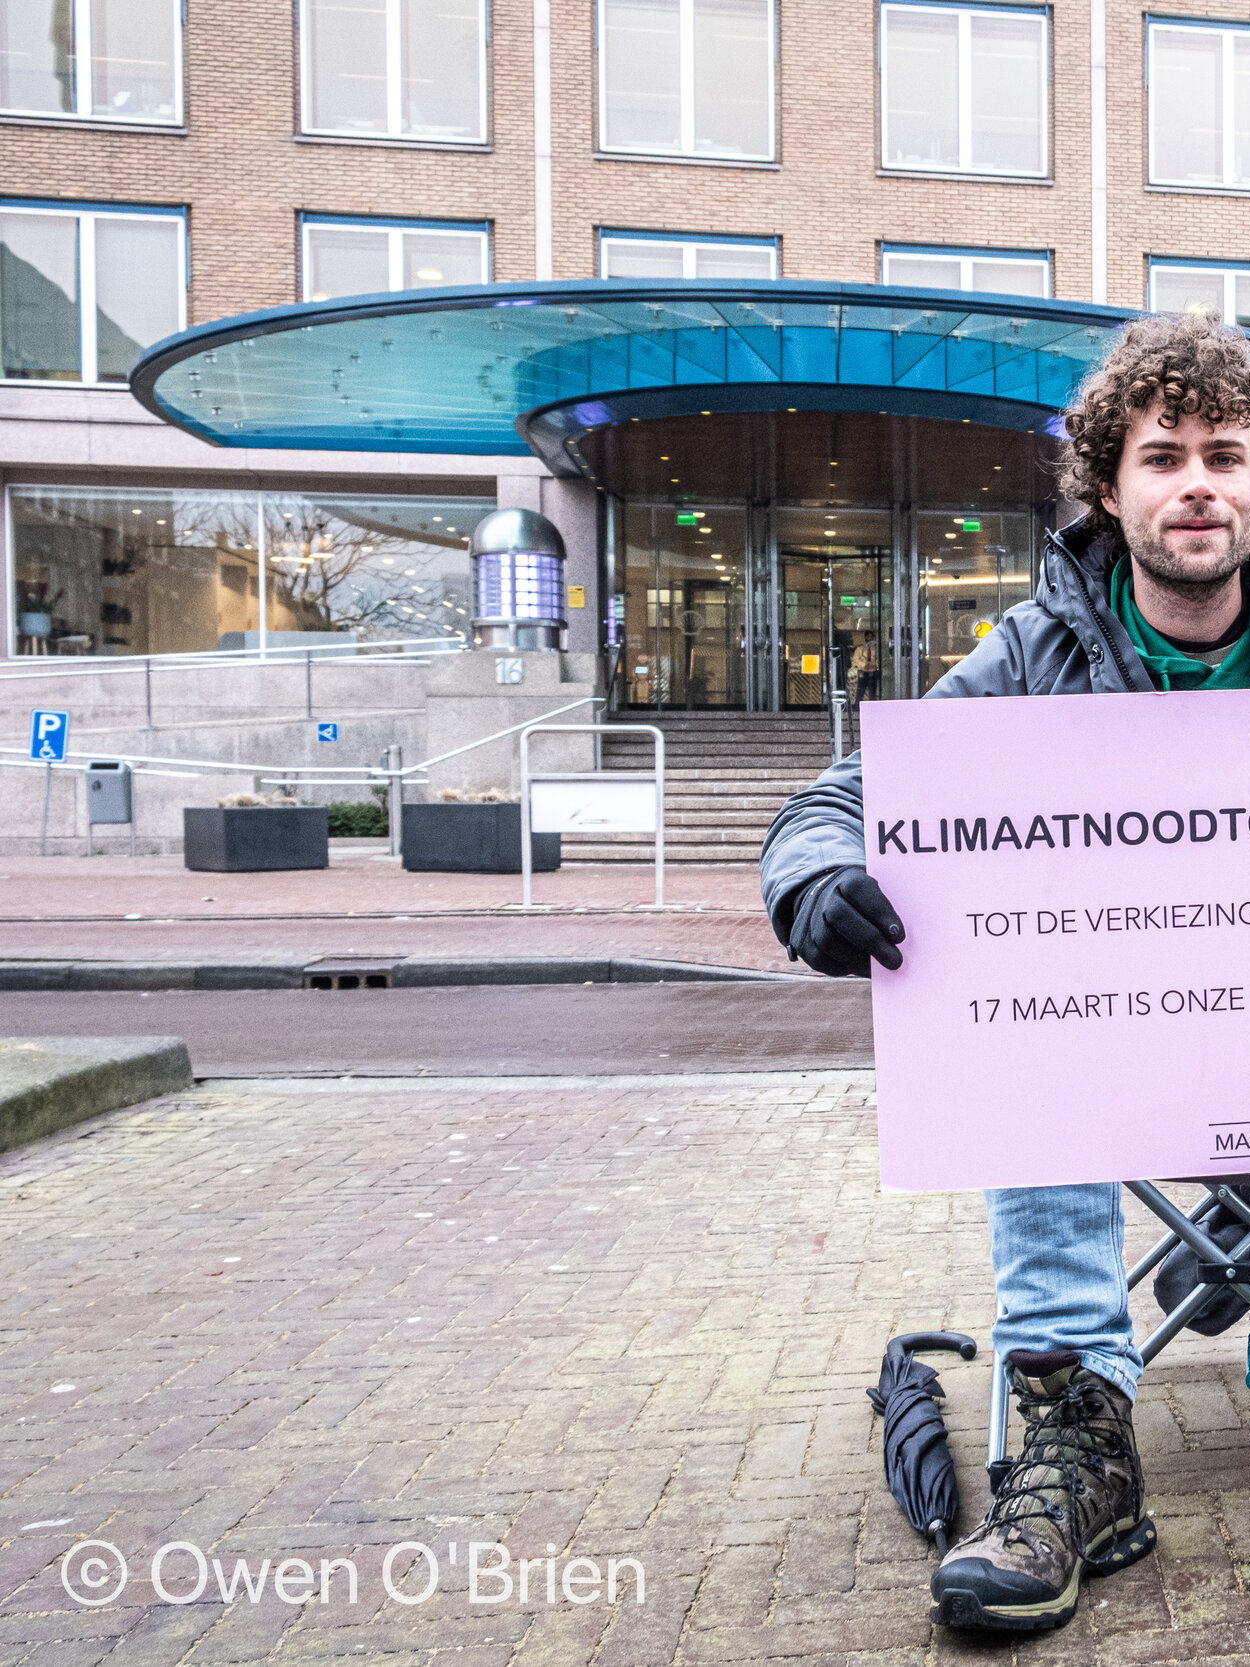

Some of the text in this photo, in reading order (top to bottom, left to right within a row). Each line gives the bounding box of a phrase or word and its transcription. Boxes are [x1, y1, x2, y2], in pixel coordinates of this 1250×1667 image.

[495, 658, 523, 685] 16
[38, 713, 61, 740] P
[965, 911, 1028, 937] TOT
[1037, 909, 1078, 935] DE
[969, 998, 1001, 1024] 17
[1012, 992, 1120, 1022] MAART
[1128, 991, 1151, 1016] IS
[1160, 986, 1245, 1015] ONZE
